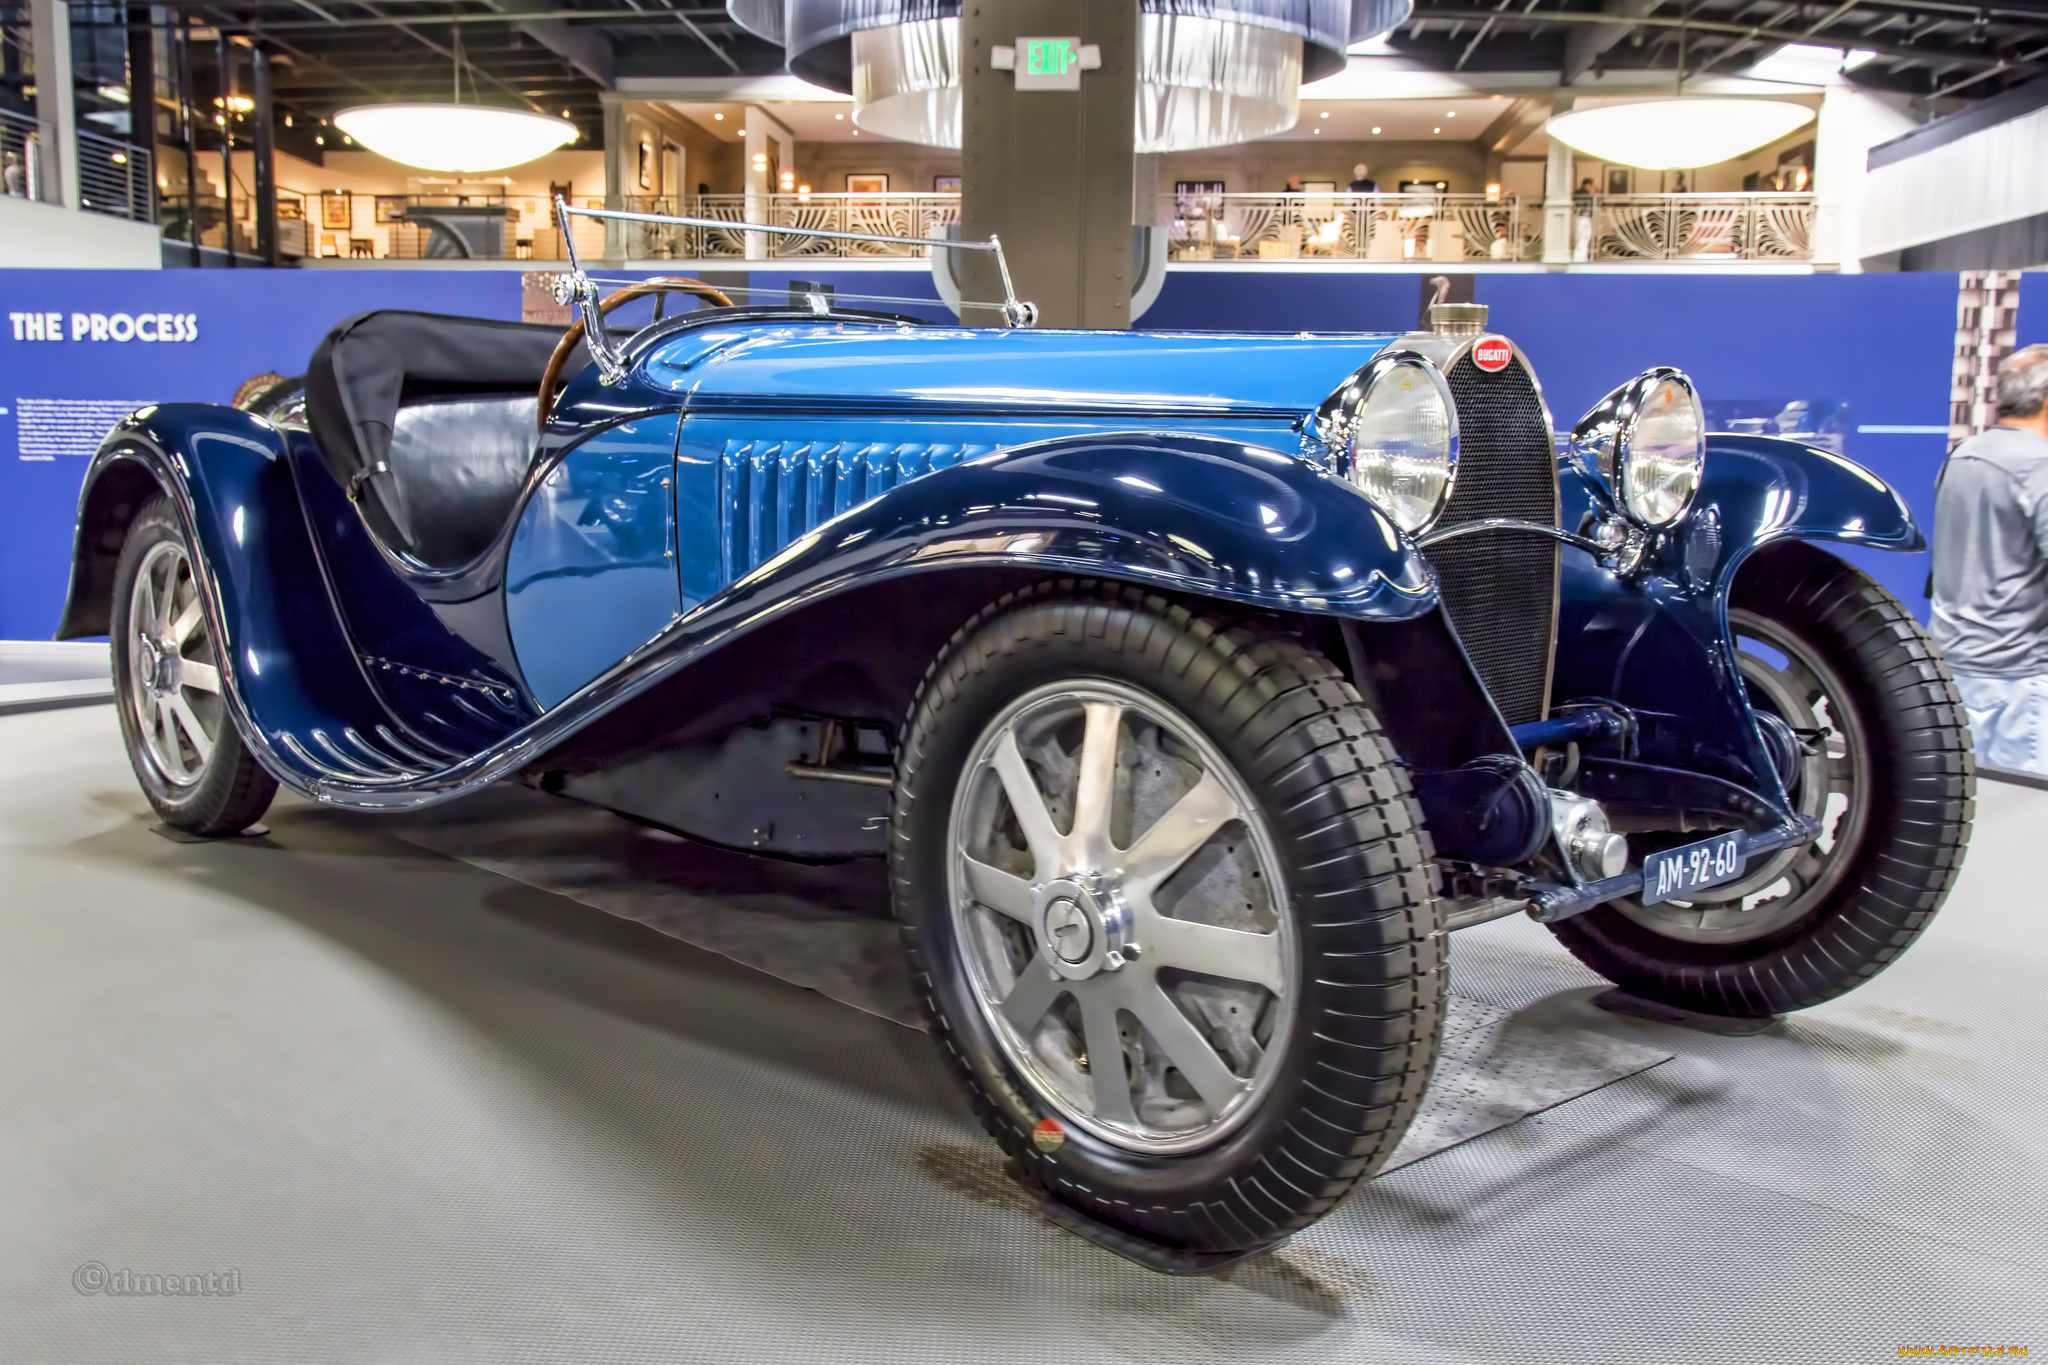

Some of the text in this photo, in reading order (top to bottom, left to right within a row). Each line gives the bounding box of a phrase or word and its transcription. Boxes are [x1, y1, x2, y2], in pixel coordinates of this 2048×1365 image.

[1028, 41, 1070, 75] EXIT
[9, 312, 199, 342] THE PROCESS
[1477, 348, 1509, 361] BUGATTI
[1655, 840, 1737, 896] AM-92-60
